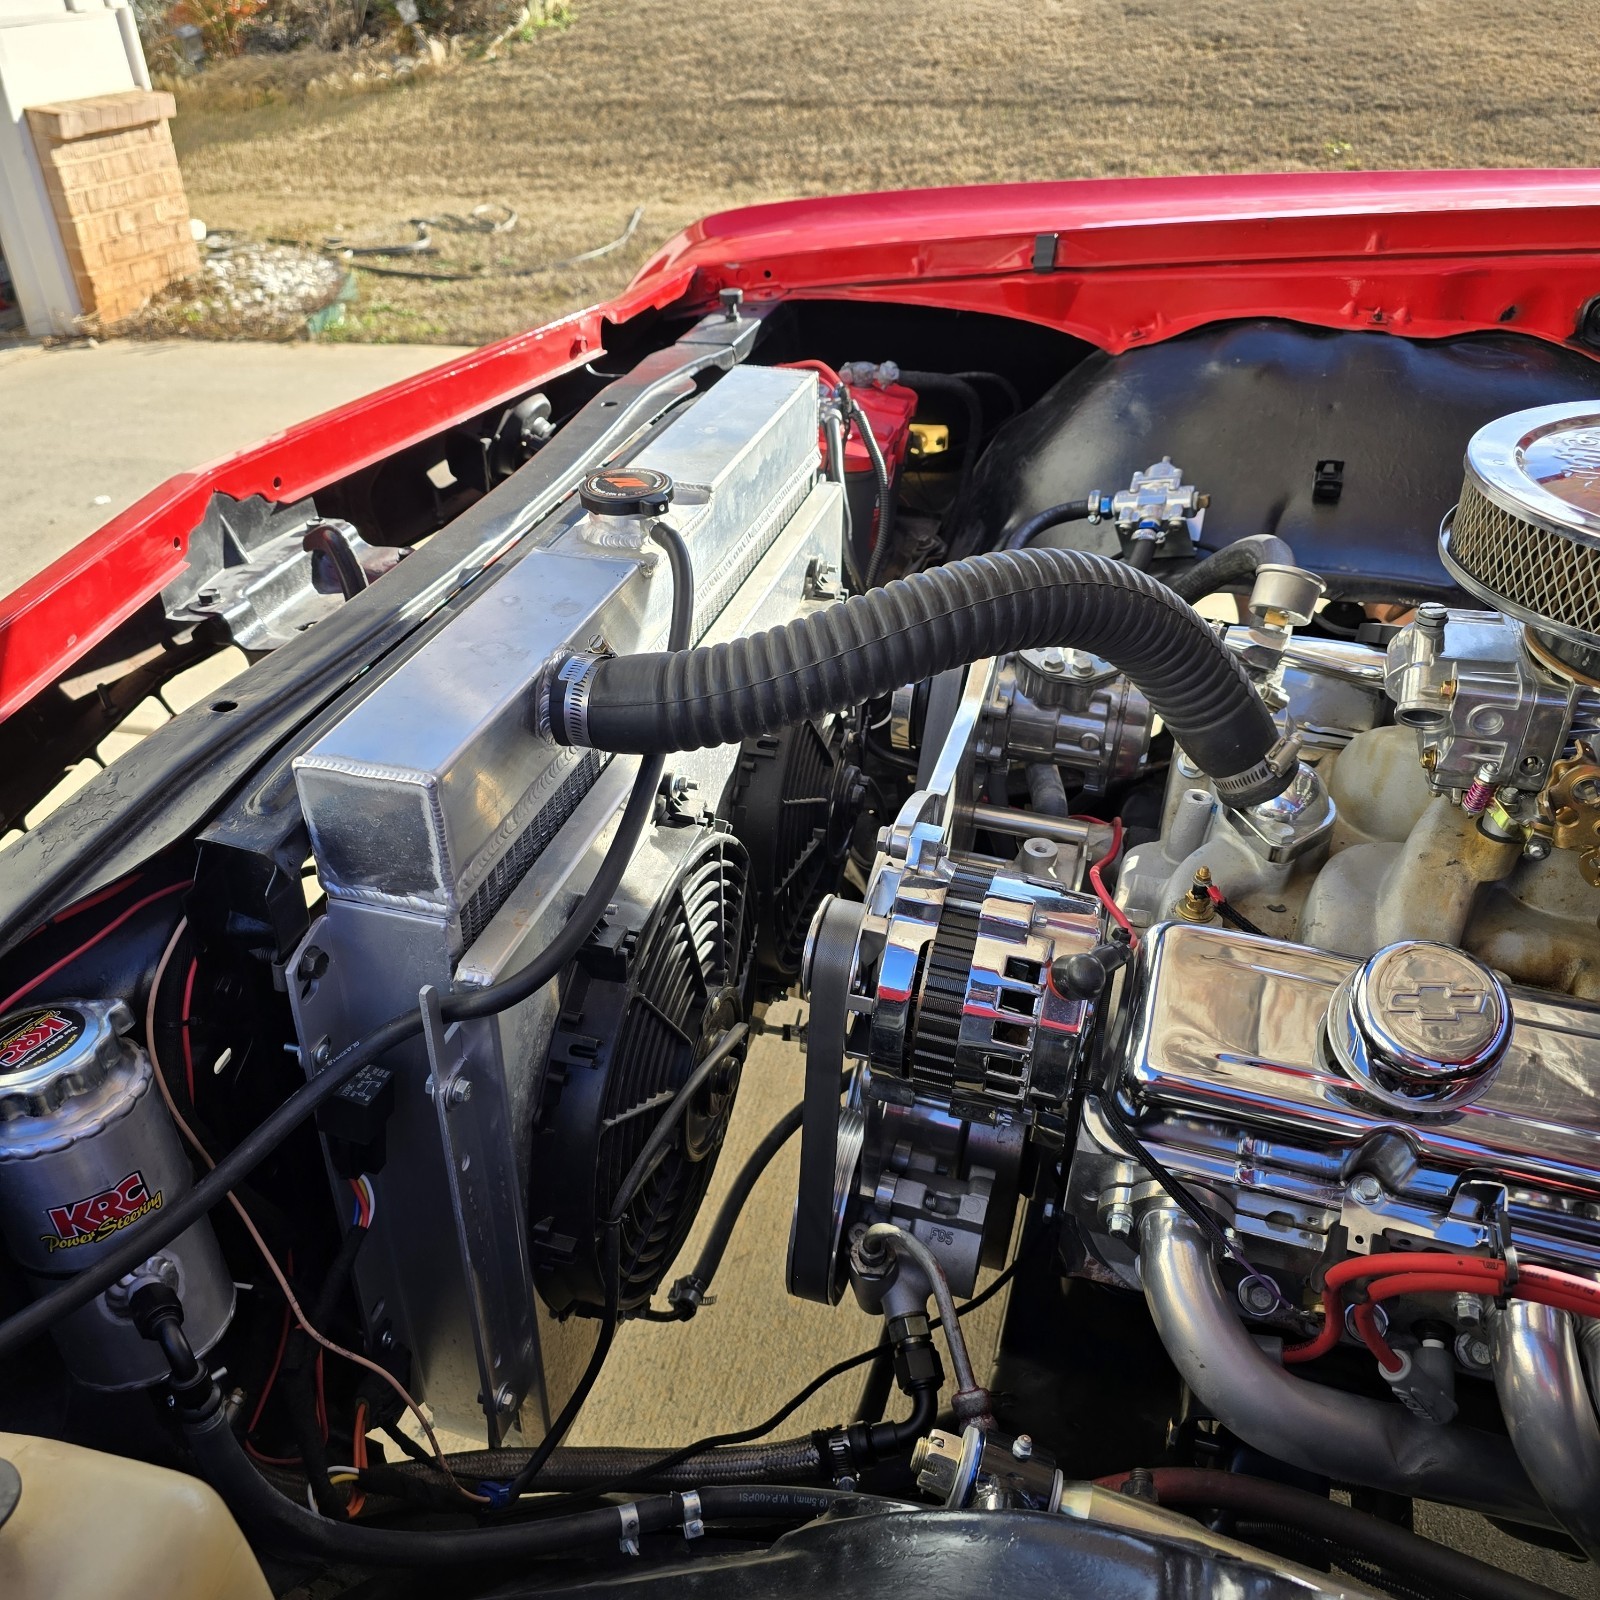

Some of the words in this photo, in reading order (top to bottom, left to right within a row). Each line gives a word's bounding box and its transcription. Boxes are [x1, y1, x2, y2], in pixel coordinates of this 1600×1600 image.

[0, 1017, 68, 1065] KRC
[46, 1035, 64, 1048] Only
[63, 1026, 79, 1036] Use
[15, 1047, 47, 1069] Genuine
[49, 1172, 149, 1239] KRC
[41, 1235, 96, 1254] Power
[95, 1191, 163, 1243] Steering
[793, 1494, 828, 1508] (9.5mm)
